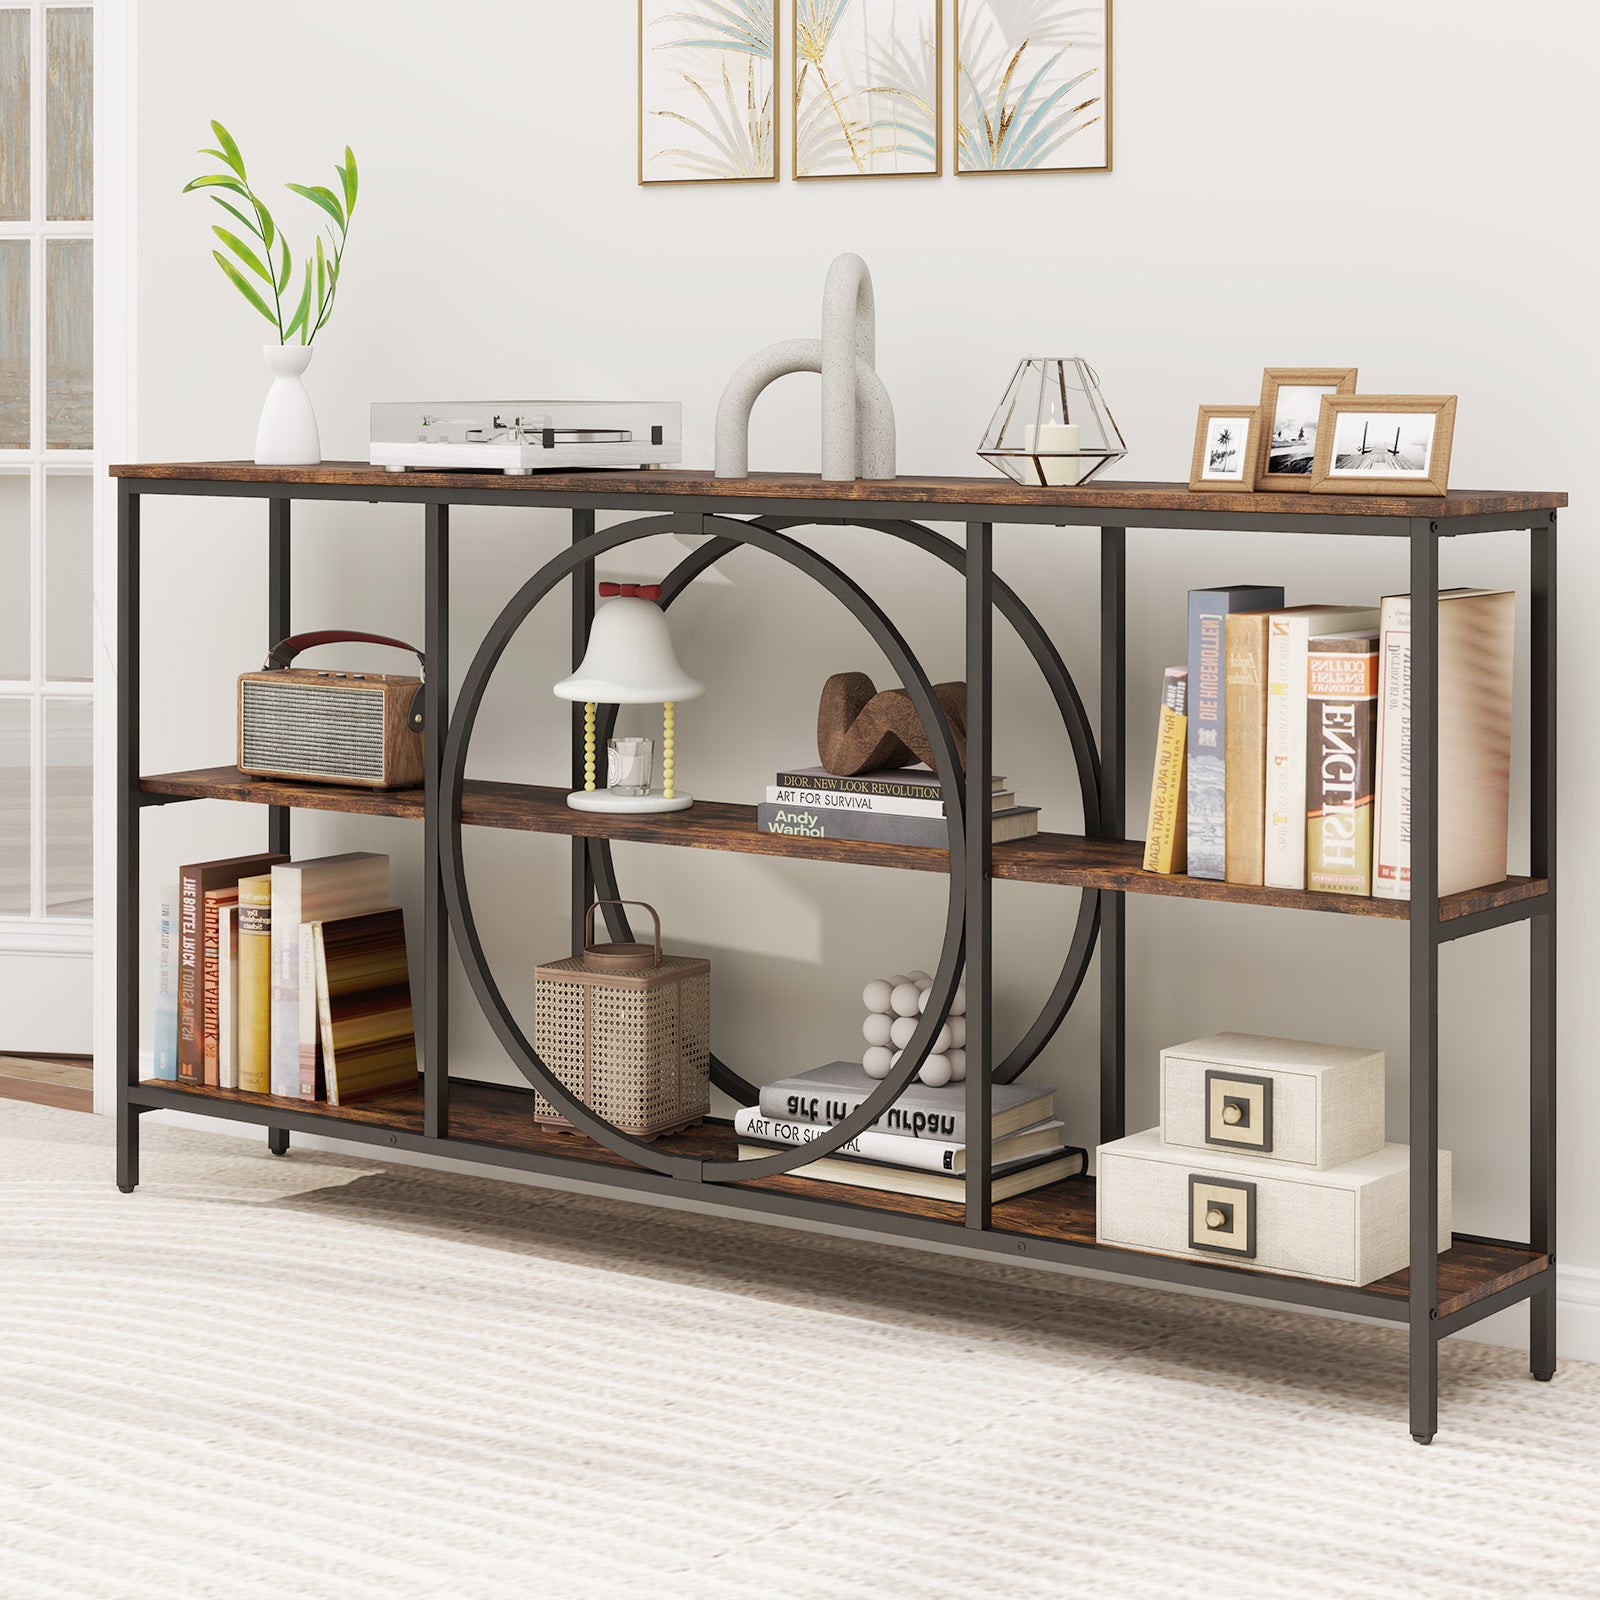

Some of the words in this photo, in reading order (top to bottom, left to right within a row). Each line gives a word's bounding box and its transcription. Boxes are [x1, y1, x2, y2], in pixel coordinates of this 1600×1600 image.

[784, 775, 812, 788] DIOR.
[813, 778, 837, 790] NEW
[839, 780, 868, 792] LOOK
[871, 783, 940, 799] REVOLUTION
[776, 790, 796, 803] ART
[800, 792, 822, 805] FOR
[824, 794, 873, 810] SURVIVAL
[775, 810, 819, 828] Andy
[768, 822, 825, 838] Warhol
[747, 1118, 769, 1136] ART
[774, 1123, 800, 1142] FOR
[803, 1128, 861, 1153] SUAL
